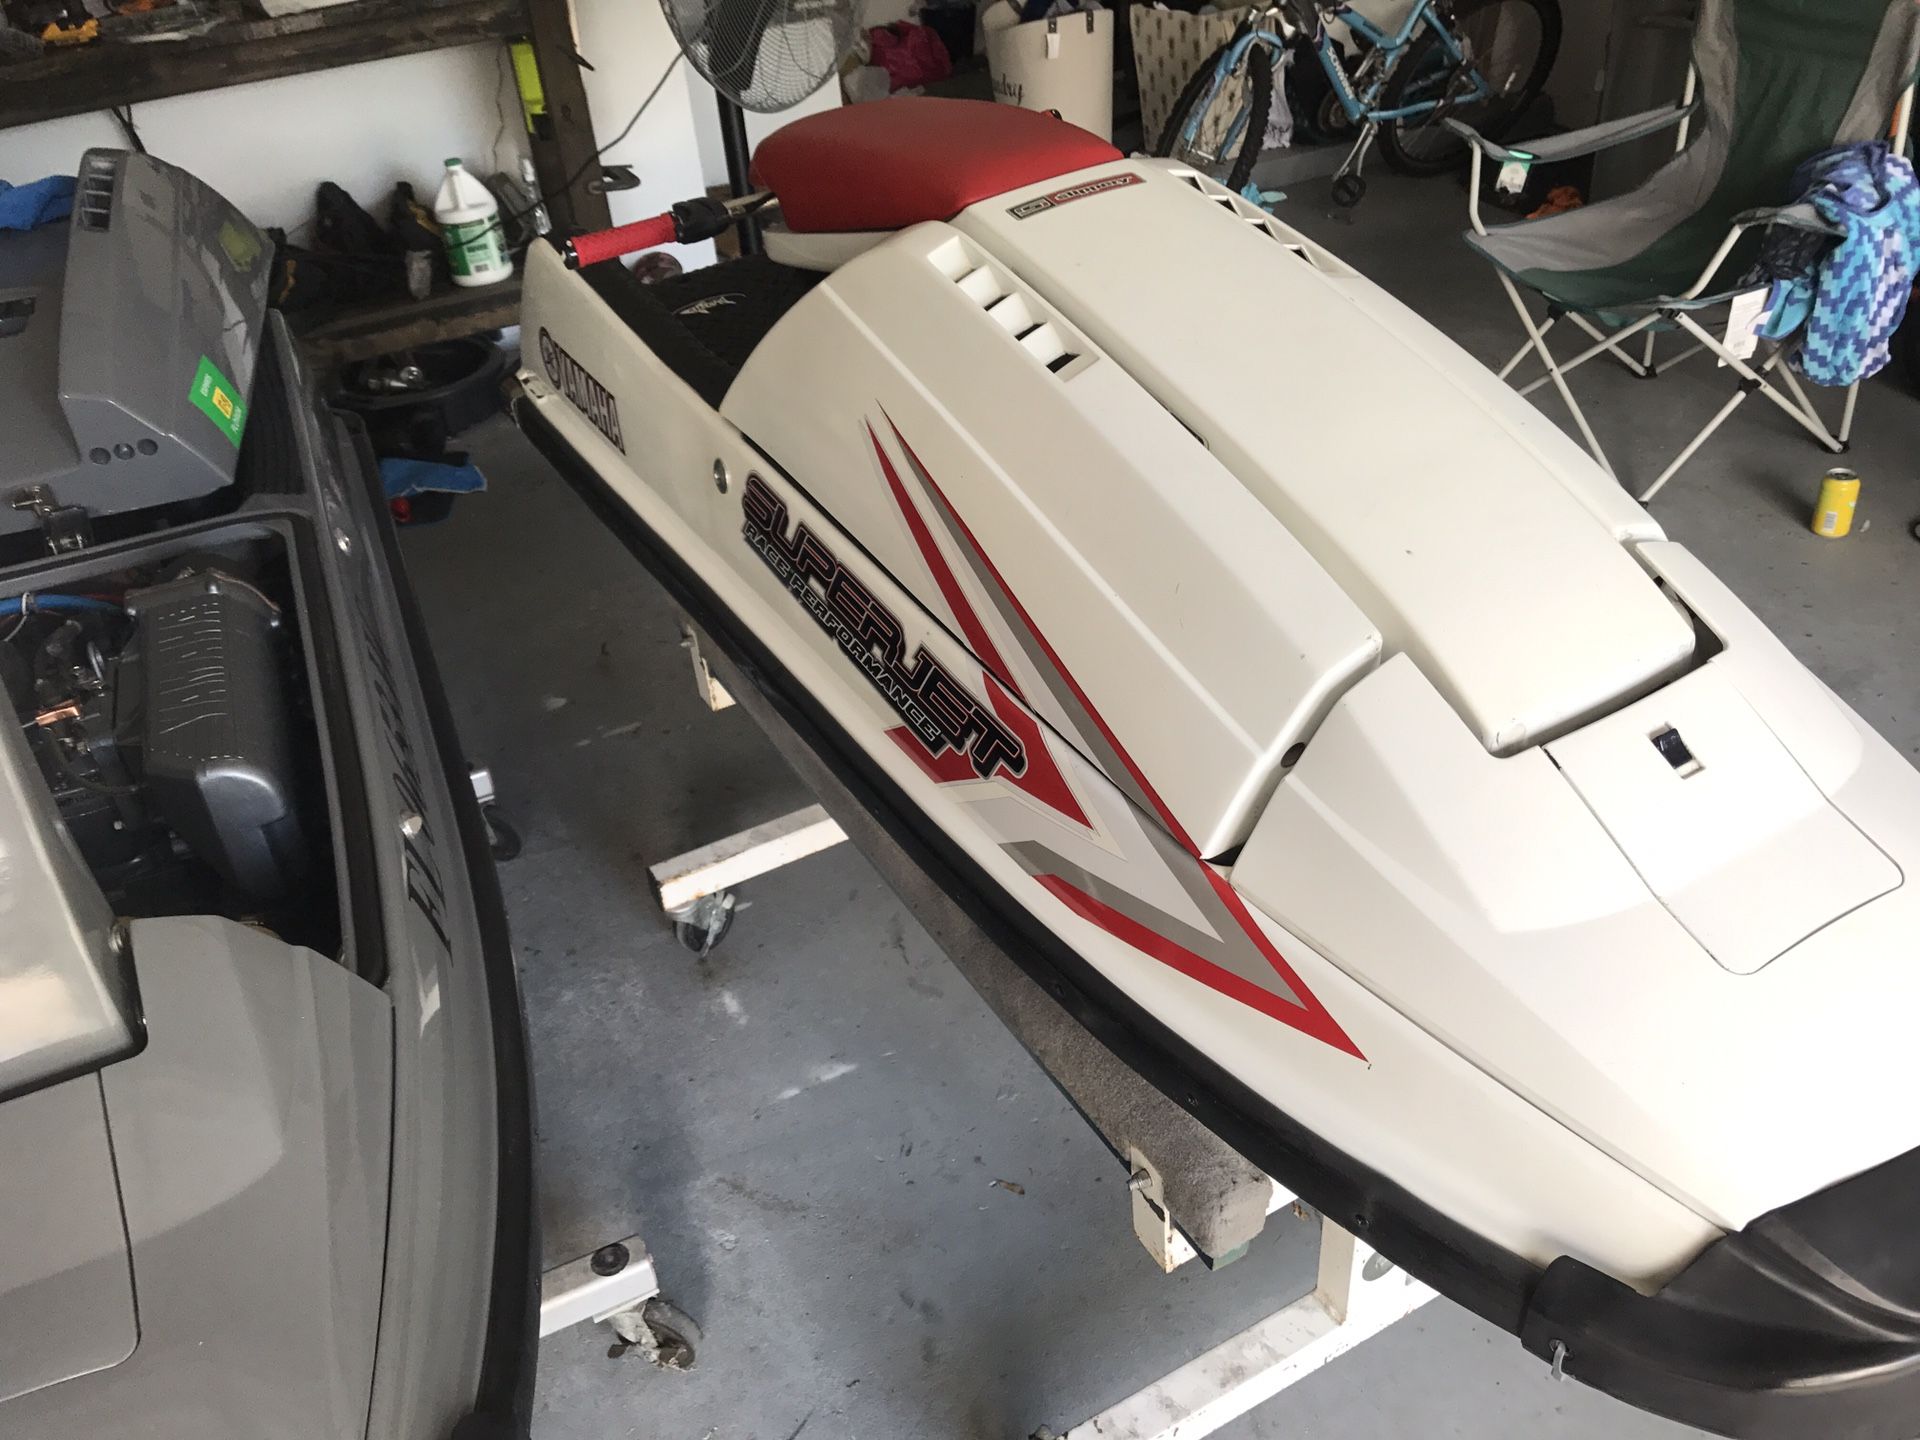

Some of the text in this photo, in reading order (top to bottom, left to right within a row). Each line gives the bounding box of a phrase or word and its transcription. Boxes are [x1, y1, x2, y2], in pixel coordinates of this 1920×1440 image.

[553, 340, 626, 457] YAMAHA
[743, 522, 942, 744] RACE PERFORMANCE
